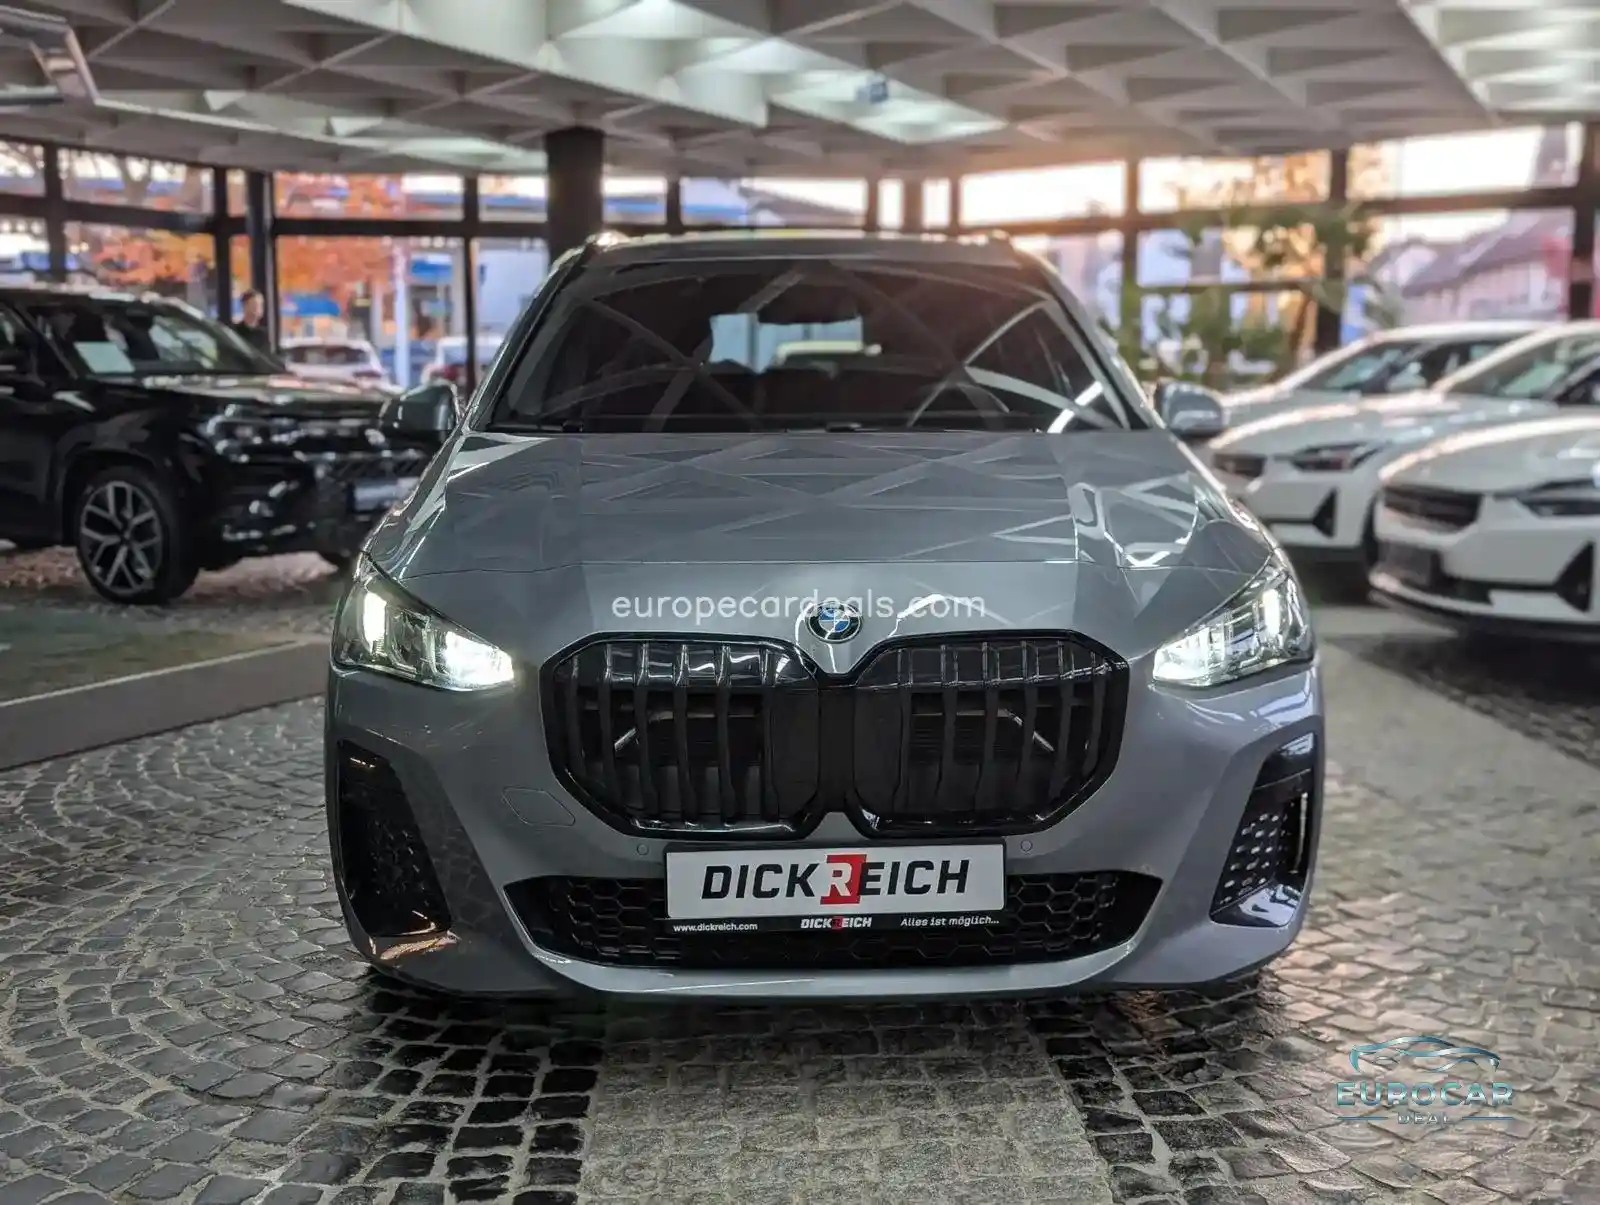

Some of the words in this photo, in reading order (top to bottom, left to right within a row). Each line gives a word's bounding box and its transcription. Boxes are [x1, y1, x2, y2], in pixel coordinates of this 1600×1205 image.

[701, 854, 970, 905] DICKREICH
[900, 917, 928, 927] Alles
[930, 917, 946, 926] ist
[948, 915, 1000, 927] möglich...
[673, 923, 758, 932] www.dickreich.com
